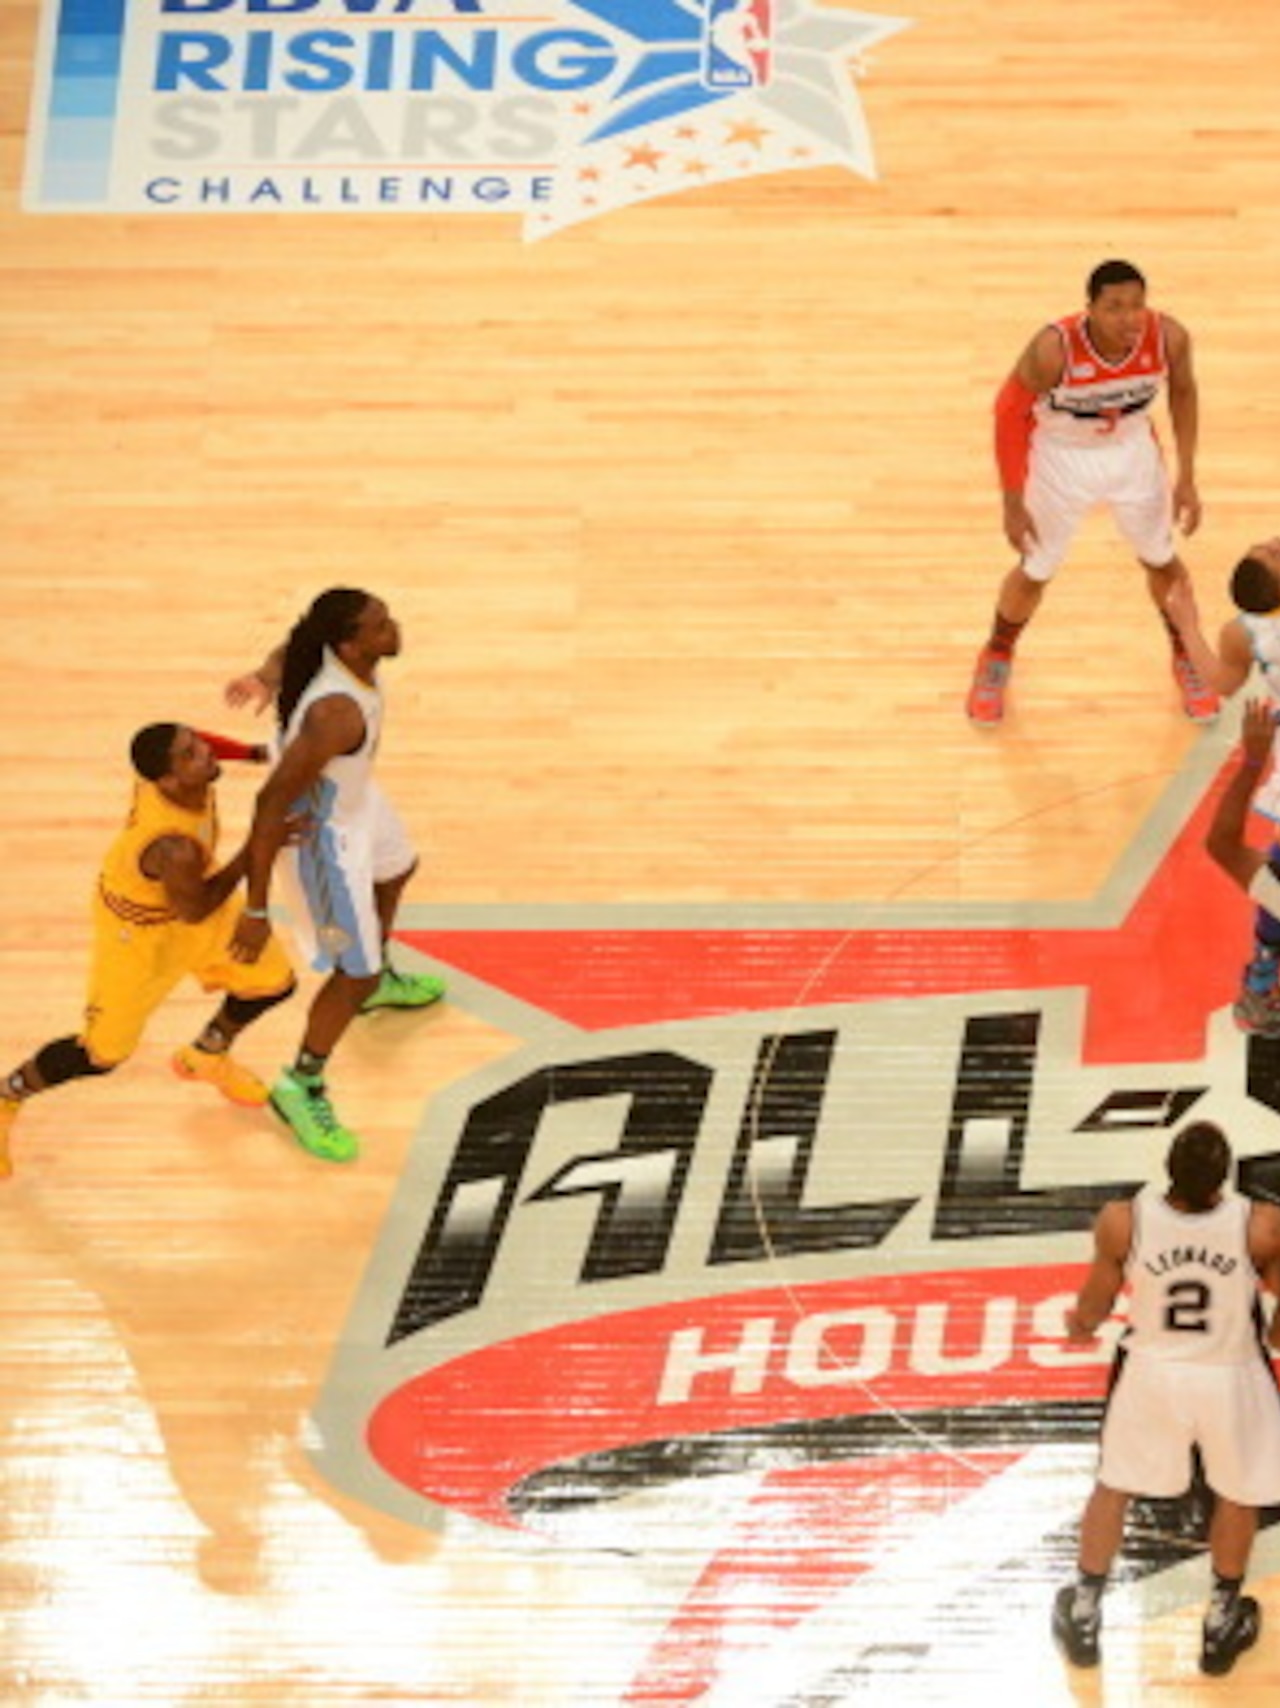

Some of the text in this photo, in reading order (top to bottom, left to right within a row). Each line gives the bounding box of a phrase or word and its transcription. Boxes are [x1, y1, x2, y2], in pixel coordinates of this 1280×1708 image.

[153, 28, 619, 91] RISING
[149, 97, 559, 161] STARS
[145, 176, 554, 204] CHALLENGE
[1144, 1245, 1238, 1277] LEONARD
[1166, 1278, 1211, 1333] 2
